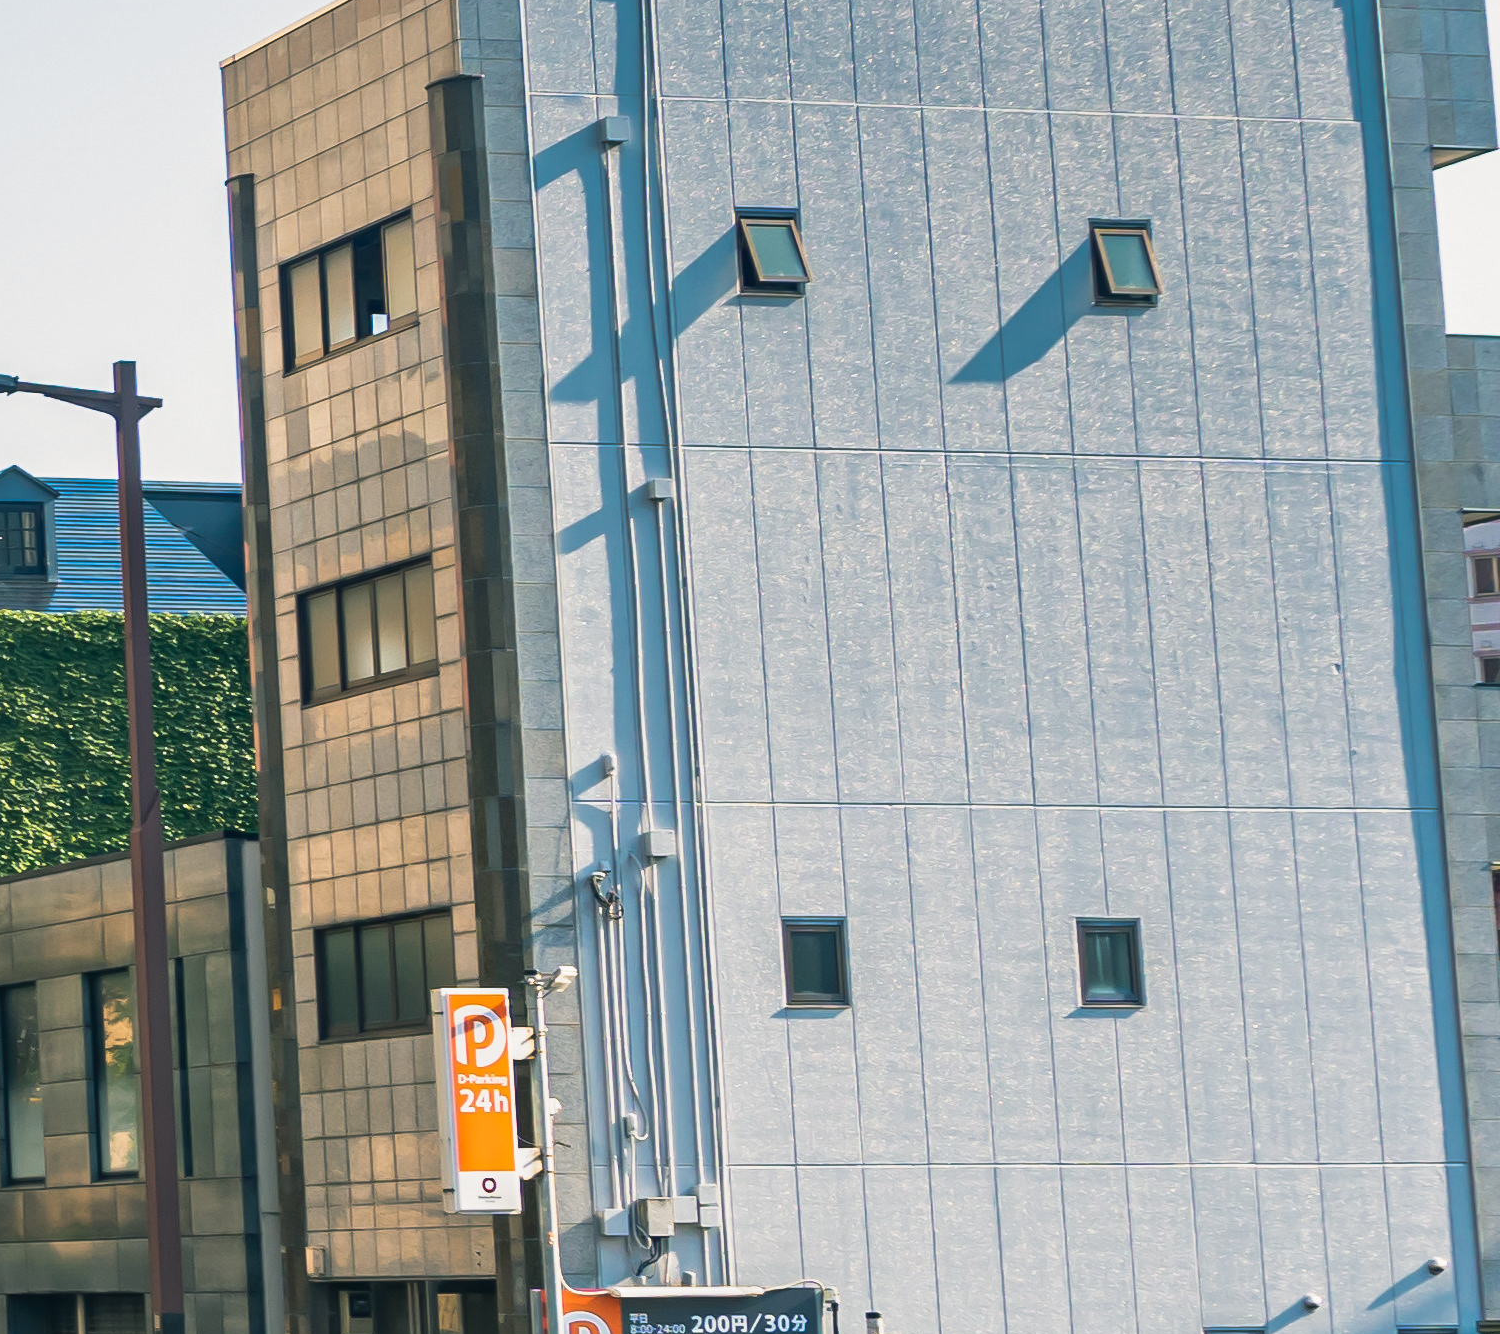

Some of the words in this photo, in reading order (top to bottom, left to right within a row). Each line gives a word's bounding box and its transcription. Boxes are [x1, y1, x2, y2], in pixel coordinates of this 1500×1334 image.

[457, 1073, 508, 1087] D-Parking
[459, 1088, 509, 1113] 24h
[629, 1313, 648, 1324] 平日
